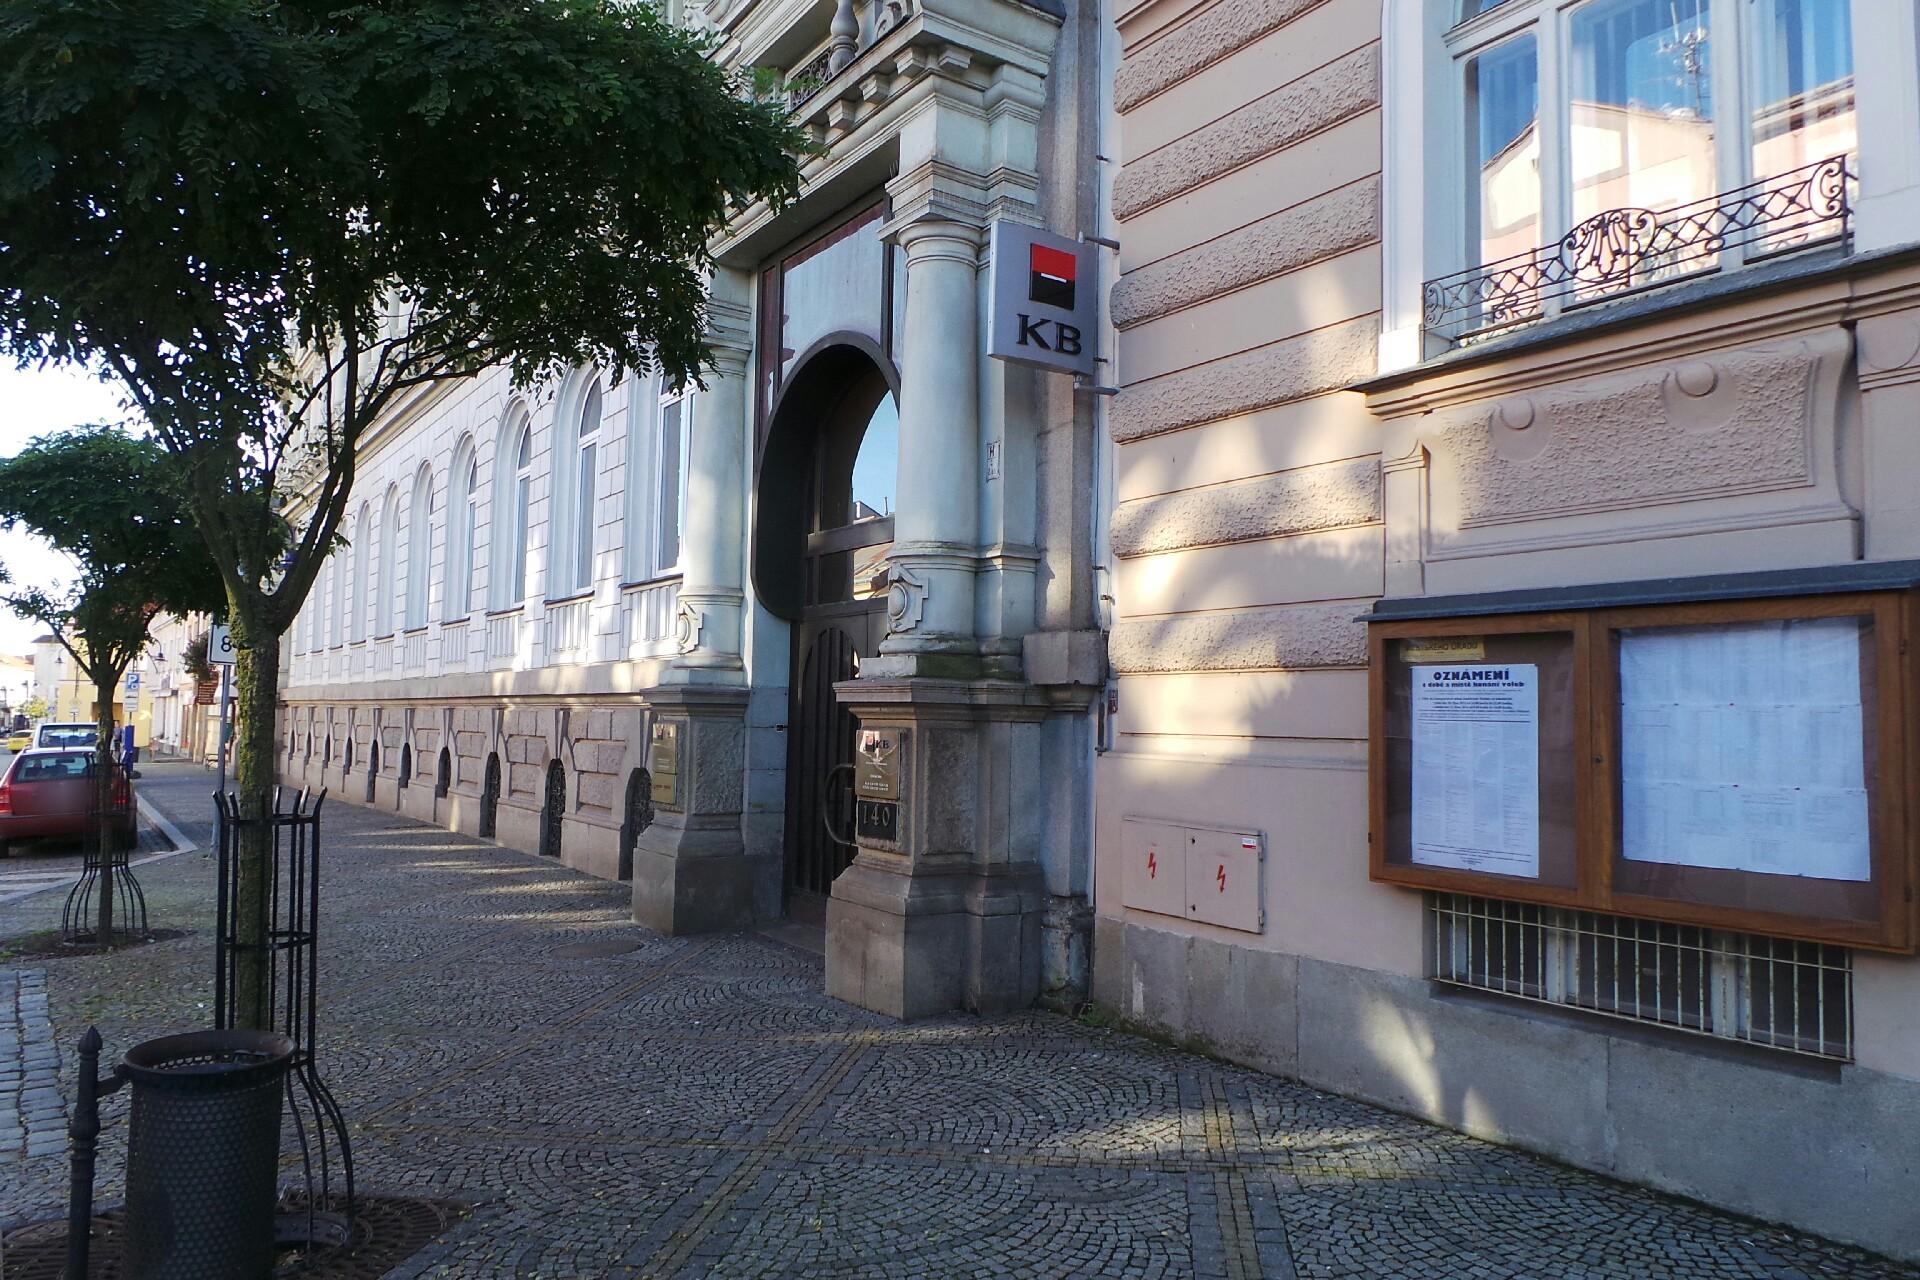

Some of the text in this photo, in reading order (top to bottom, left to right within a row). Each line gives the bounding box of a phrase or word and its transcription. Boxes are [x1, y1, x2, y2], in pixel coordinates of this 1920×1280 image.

[1016, 313, 1082, 355] KB
[221, 635, 232, 652] 8
[1433, 668, 1510, 681] OZNÁMENÍ
[863, 803, 890, 827] 140
